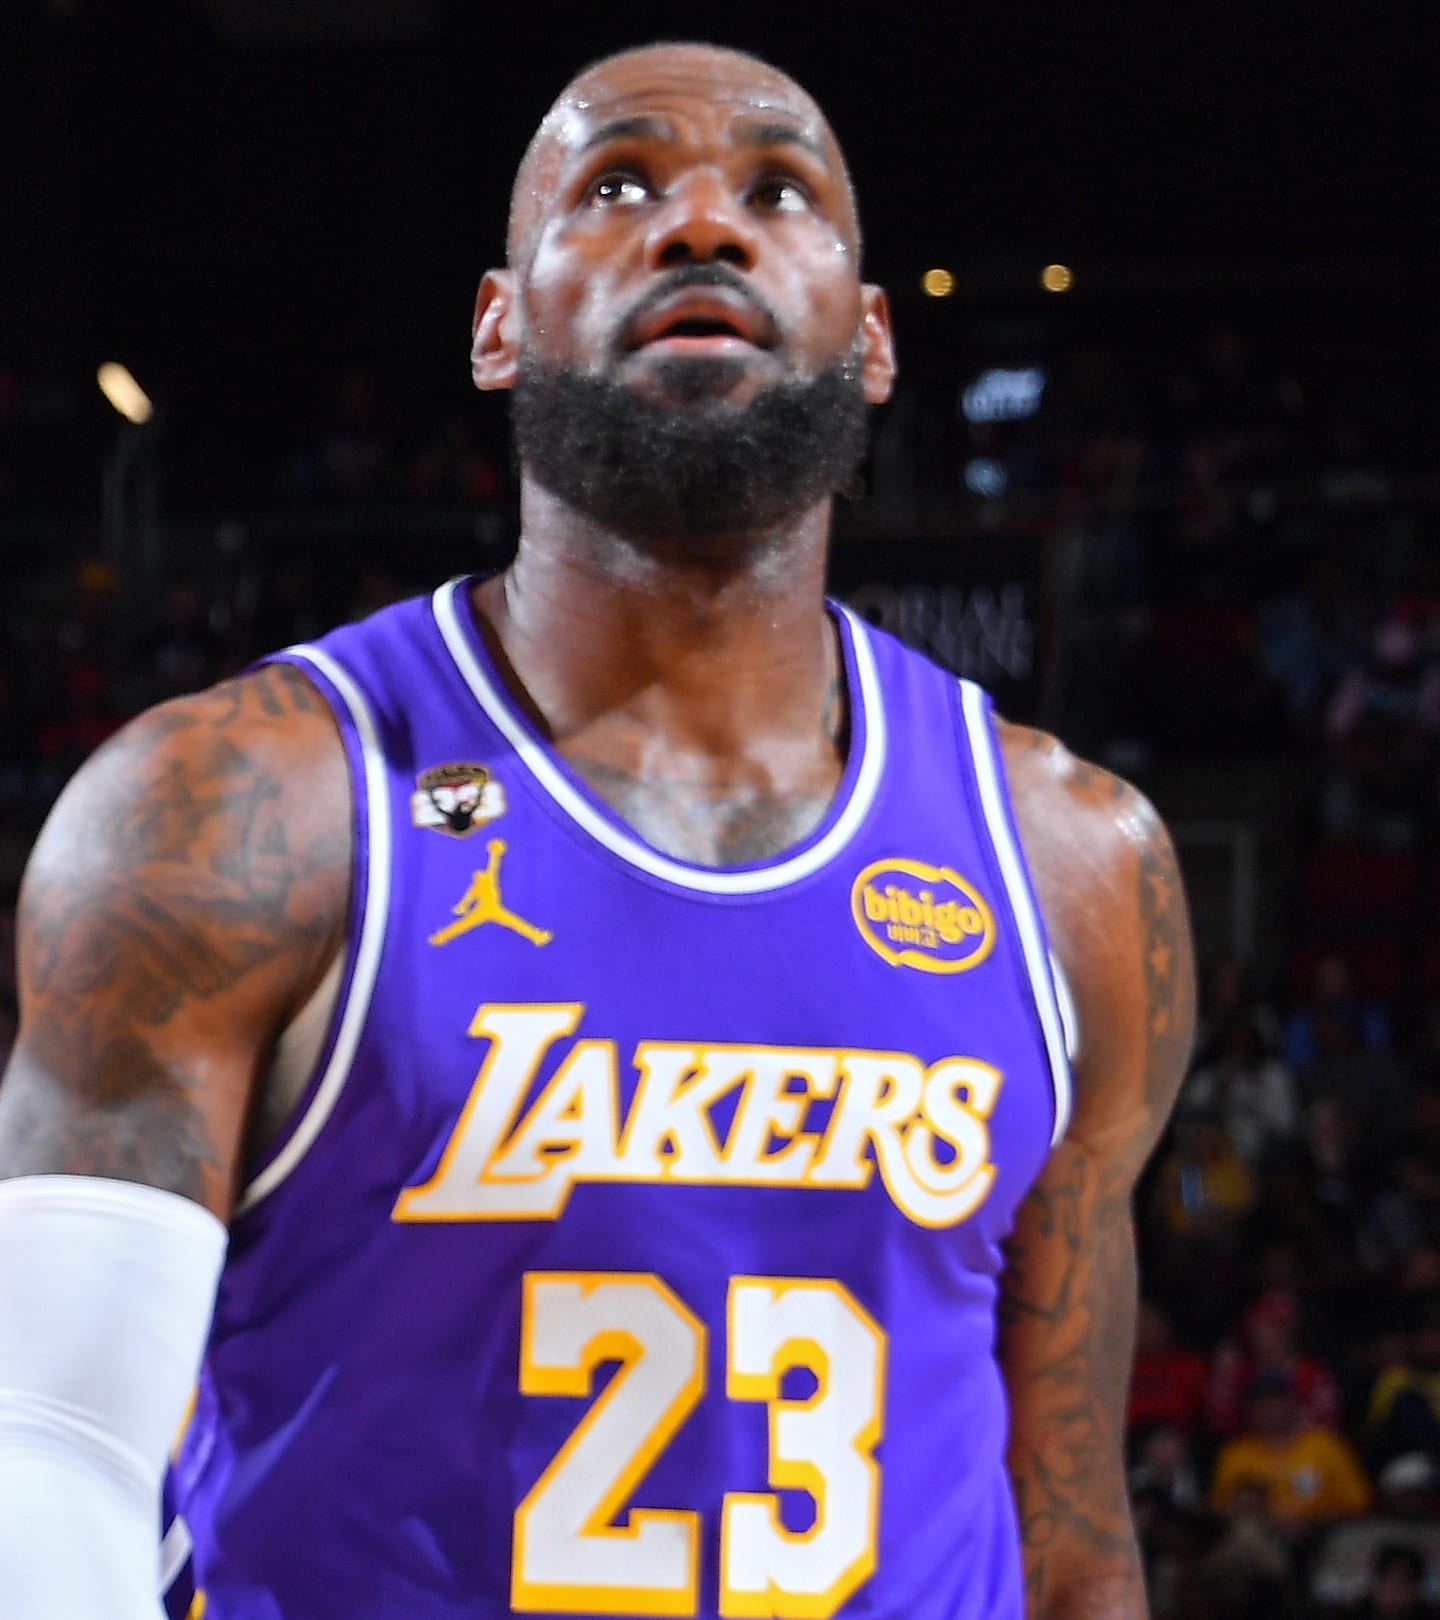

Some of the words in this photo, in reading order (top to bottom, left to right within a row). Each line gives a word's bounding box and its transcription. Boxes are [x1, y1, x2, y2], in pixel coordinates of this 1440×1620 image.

[863, 886, 985, 944] bibigo
[391, 1001, 1003, 1230] LAKERS
[510, 1270, 888, 1619] 23
